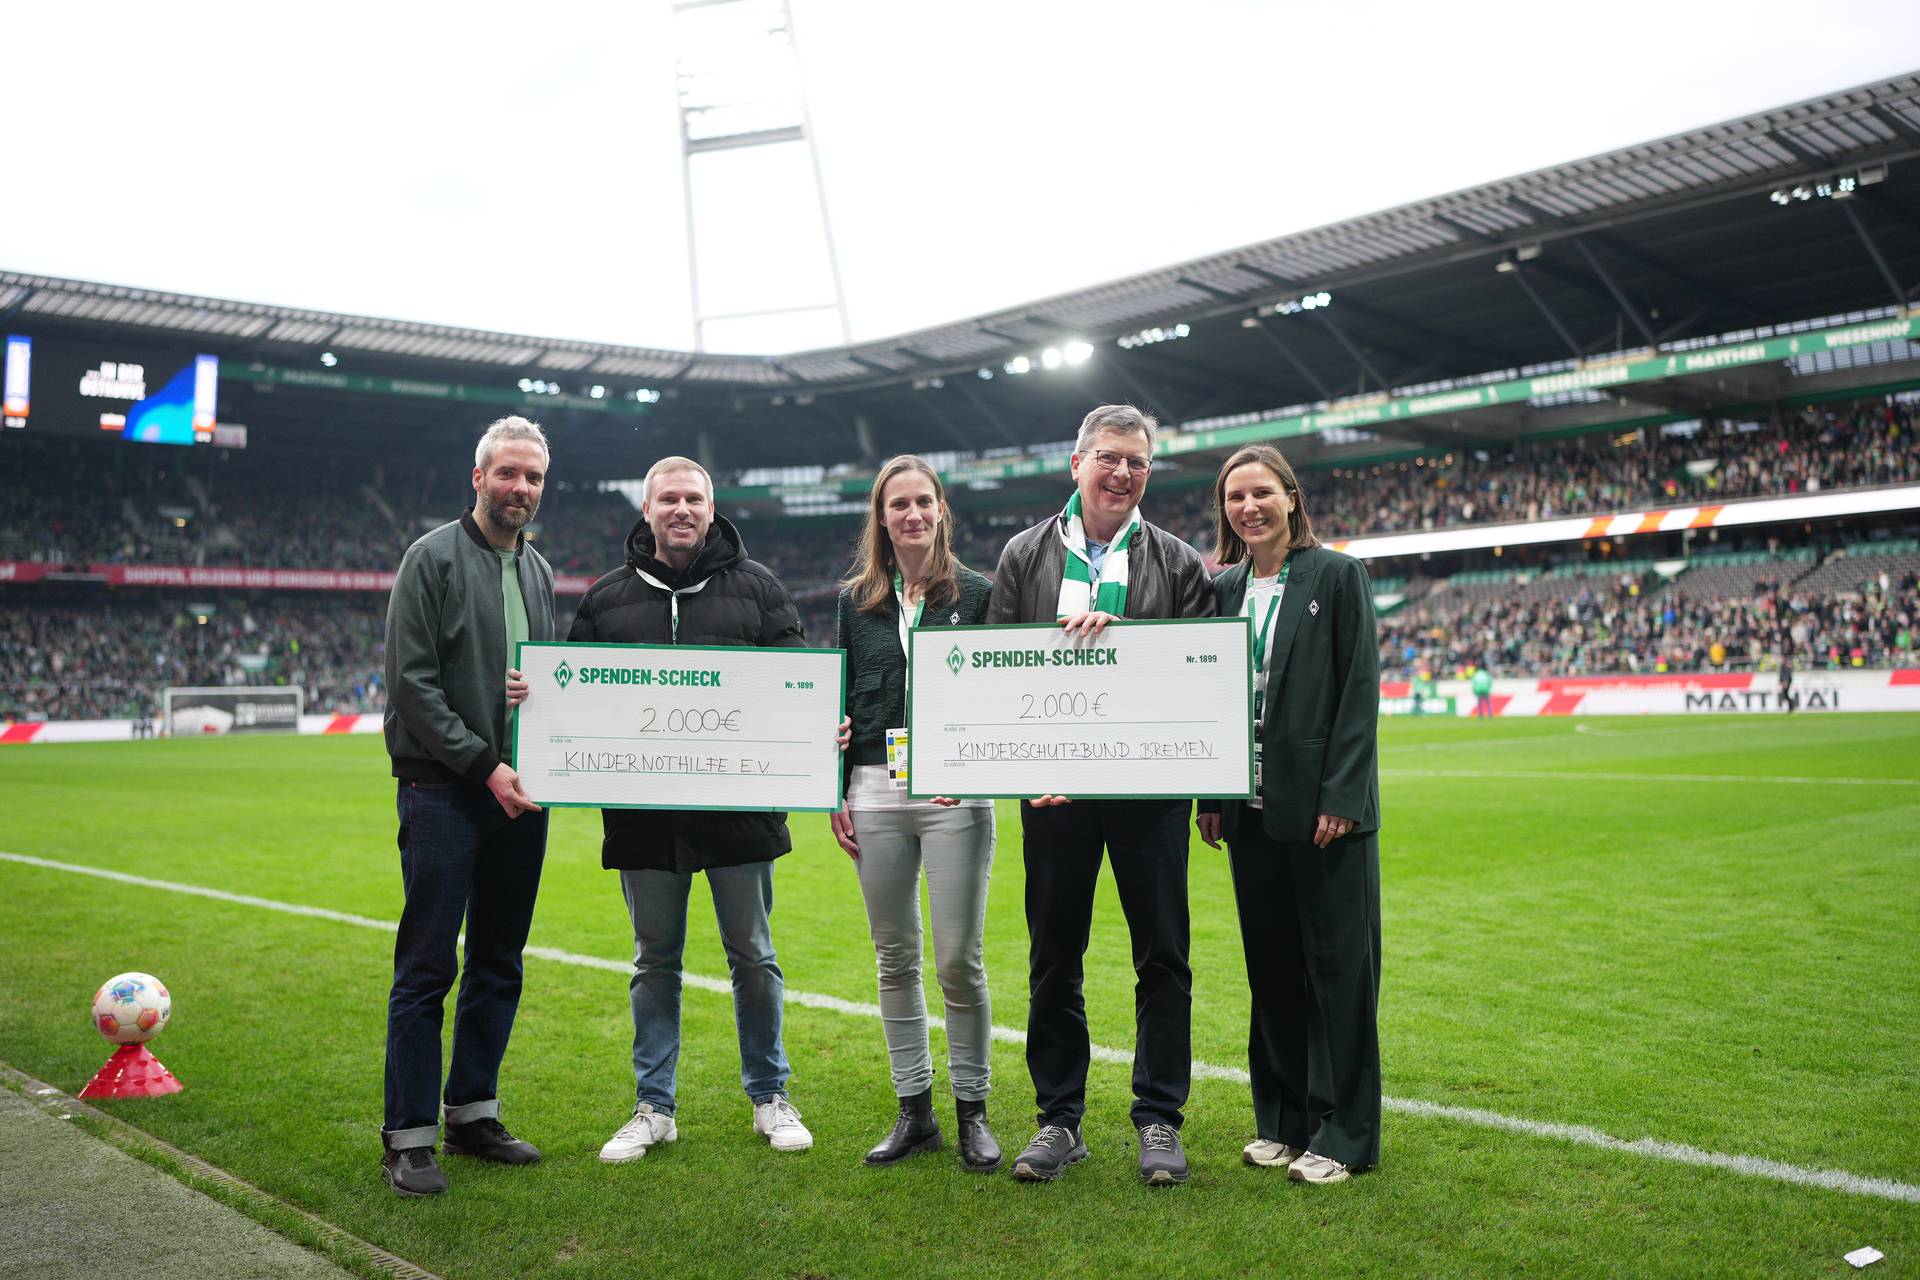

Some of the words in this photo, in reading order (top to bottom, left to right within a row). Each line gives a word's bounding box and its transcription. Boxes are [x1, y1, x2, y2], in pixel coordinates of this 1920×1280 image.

[1825, 321, 1911, 347] WIESENHOF
[971, 646, 1118, 668] SPENDEN-SCHECK
[1186, 655, 1198, 664] Nr.
[1199, 655, 1218, 663] 1899
[579, 667, 721, 687] SPENDEN-SCHECK
[785, 681, 796, 689] Nr.
[797, 681, 814, 689] 1899
[1019, 692, 1109, 719] 2.000€
[640, 707, 742, 733] 2.000€
[958, 742, 1130, 760] KINDERSCHUTZBUND
[1139, 739, 1213, 759] BREMEN
[563, 751, 728, 773] KINDERNOTHILFE
